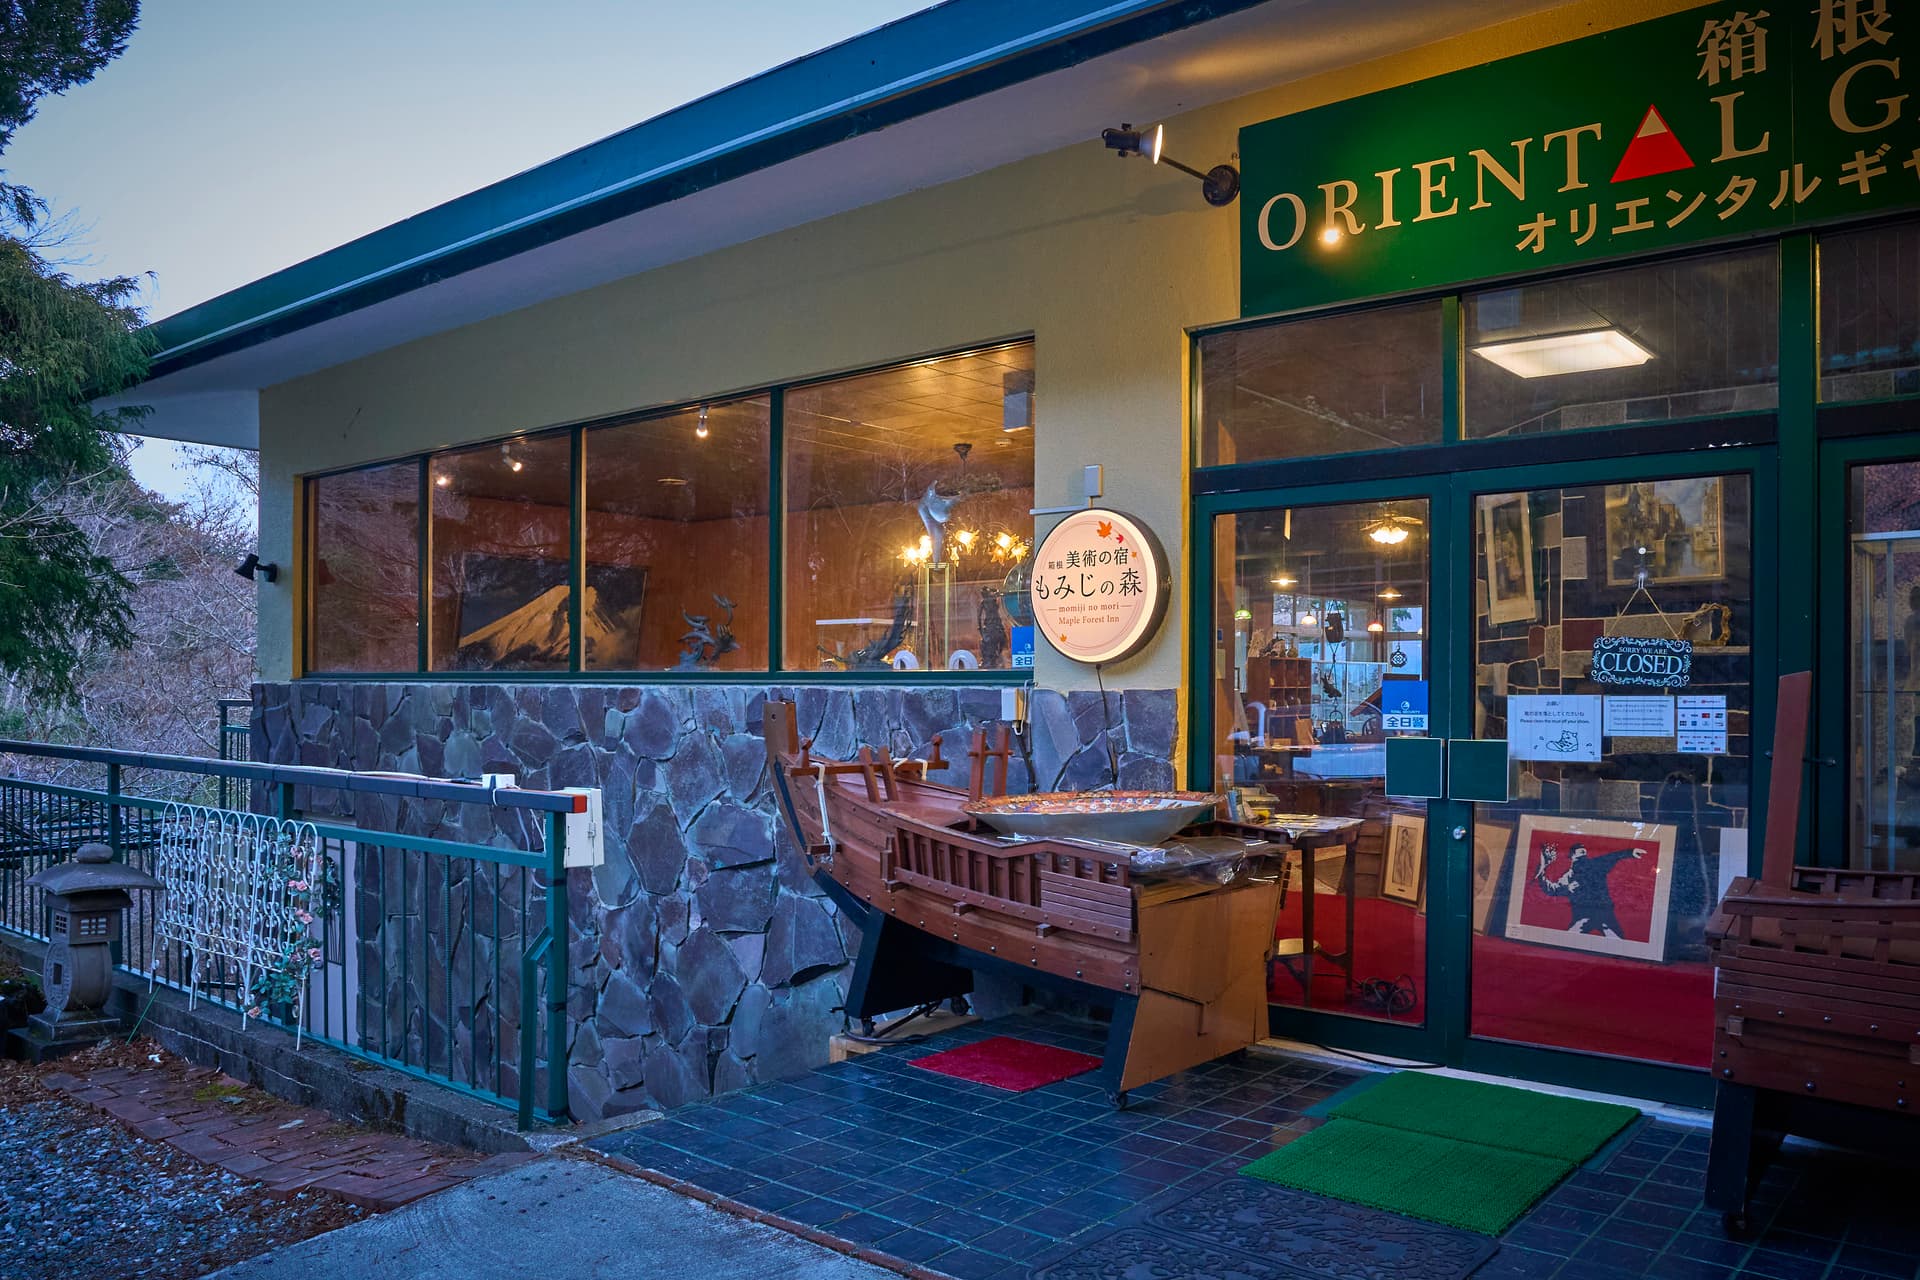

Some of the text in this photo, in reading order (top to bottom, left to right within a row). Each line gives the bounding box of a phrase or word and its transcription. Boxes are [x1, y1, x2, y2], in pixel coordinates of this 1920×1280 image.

[1829, 57, 1920, 133] G
[1048, 547, 1129, 569] 箱根 美術の宿
[1035, 568, 1143, 600] もみじの森
[1058, 603, 1086, 614] momiji
[1100, 602, 1119, 611] mori
[1058, 614, 1120, 627] Maple Forest Inn
[1015, 656, 1035, 666] 全日
[1600, 652, 1683, 675] CLOSED
[1386, 716, 1425, 728] 全日警
